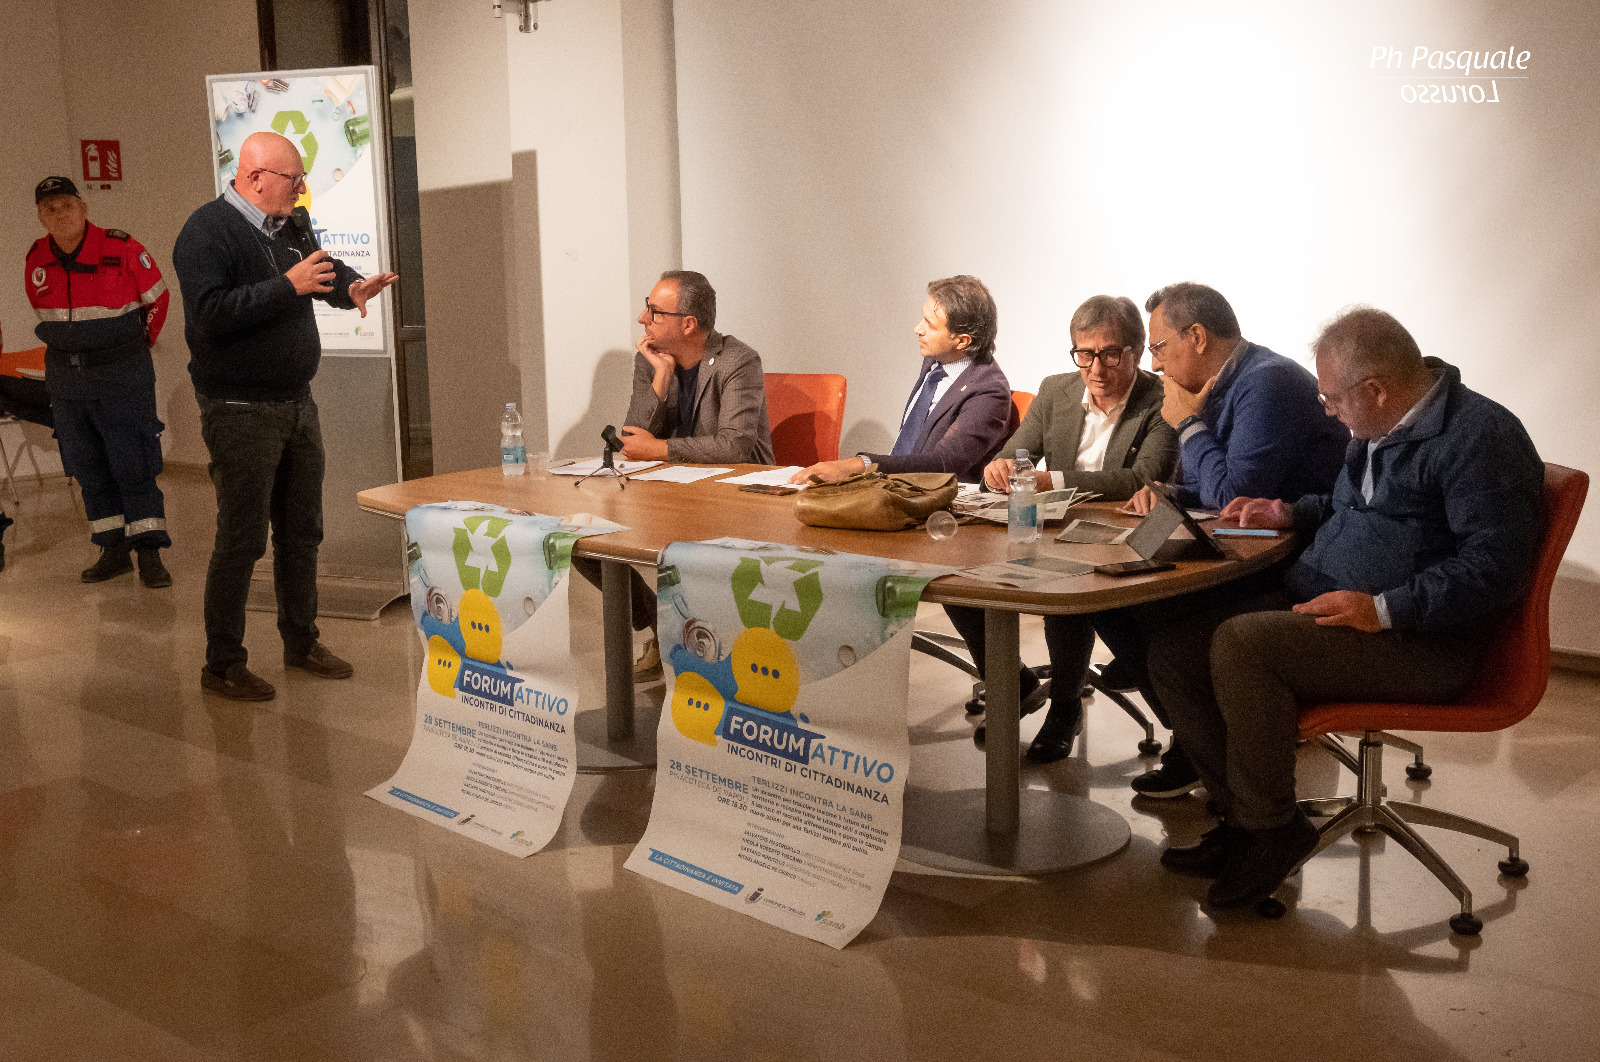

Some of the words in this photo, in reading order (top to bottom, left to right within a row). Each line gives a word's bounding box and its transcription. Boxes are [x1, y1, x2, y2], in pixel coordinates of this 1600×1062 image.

[322, 232, 370, 245] ATTIVO
[463, 670, 512, 700] FORUM
[514, 686, 568, 716] ATTIVO
[424, 714, 432, 724] 28
[434, 718, 476, 738] SETTEMBRE
[462, 694, 496, 712] INCONTRI
[498, 706, 506, 716] DI
[508, 708, 566, 734] CITTADINANZA
[478, 720, 502, 734] TERLIZZI
[502, 730, 532, 742] INCONTRA
[730, 716, 806, 756] FORUM
[811, 742, 894, 784] ATTIVO
[670, 760, 682, 772] 28
[685, 764, 748, 794] SETTEMBRE
[727, 744, 781, 769] INCONTRI
[784, 762, 796, 774] DI
[800, 767, 890, 806] CITTADINANZA
[717, 796, 730, 806] ORE
[752, 776, 788, 794] TERLIZZI
[790, 789, 834, 808] INCONTRA
[837, 802, 847, 813] LA
[850, 808, 872, 822] SANB
[664, 859, 706, 879] CITTADINANZA
[712, 876, 738, 892] INVITATA
